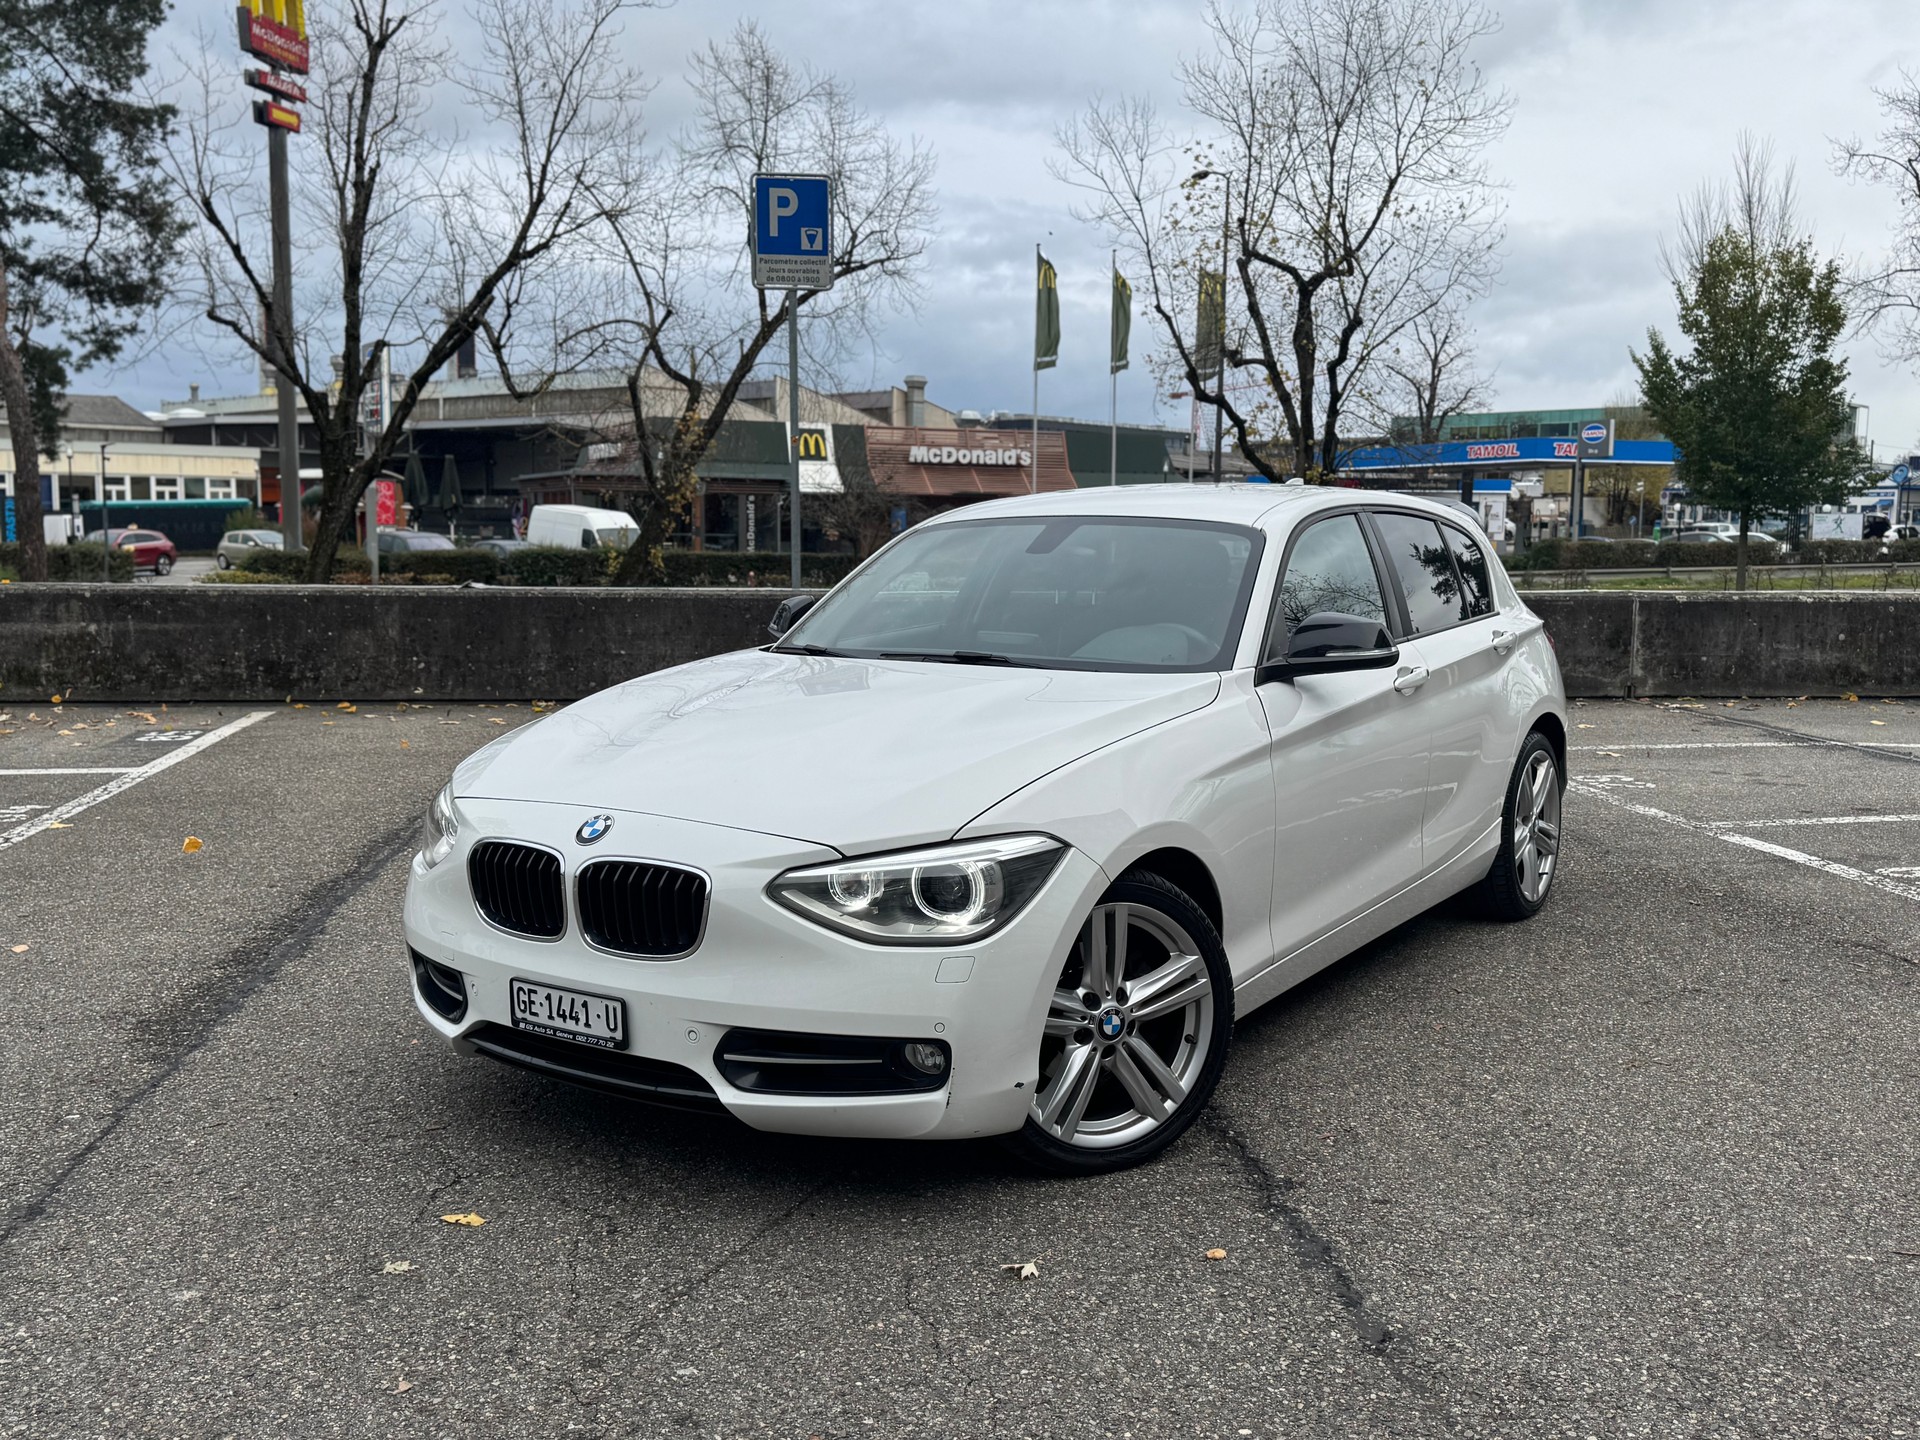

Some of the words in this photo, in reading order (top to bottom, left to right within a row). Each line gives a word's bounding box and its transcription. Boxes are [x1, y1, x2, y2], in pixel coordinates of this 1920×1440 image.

[769, 187, 799, 237] P
[799, 258, 826, 266] collectif
[909, 445, 1031, 466] McDonald's
[1467, 443, 1520, 459] TAMOIL
